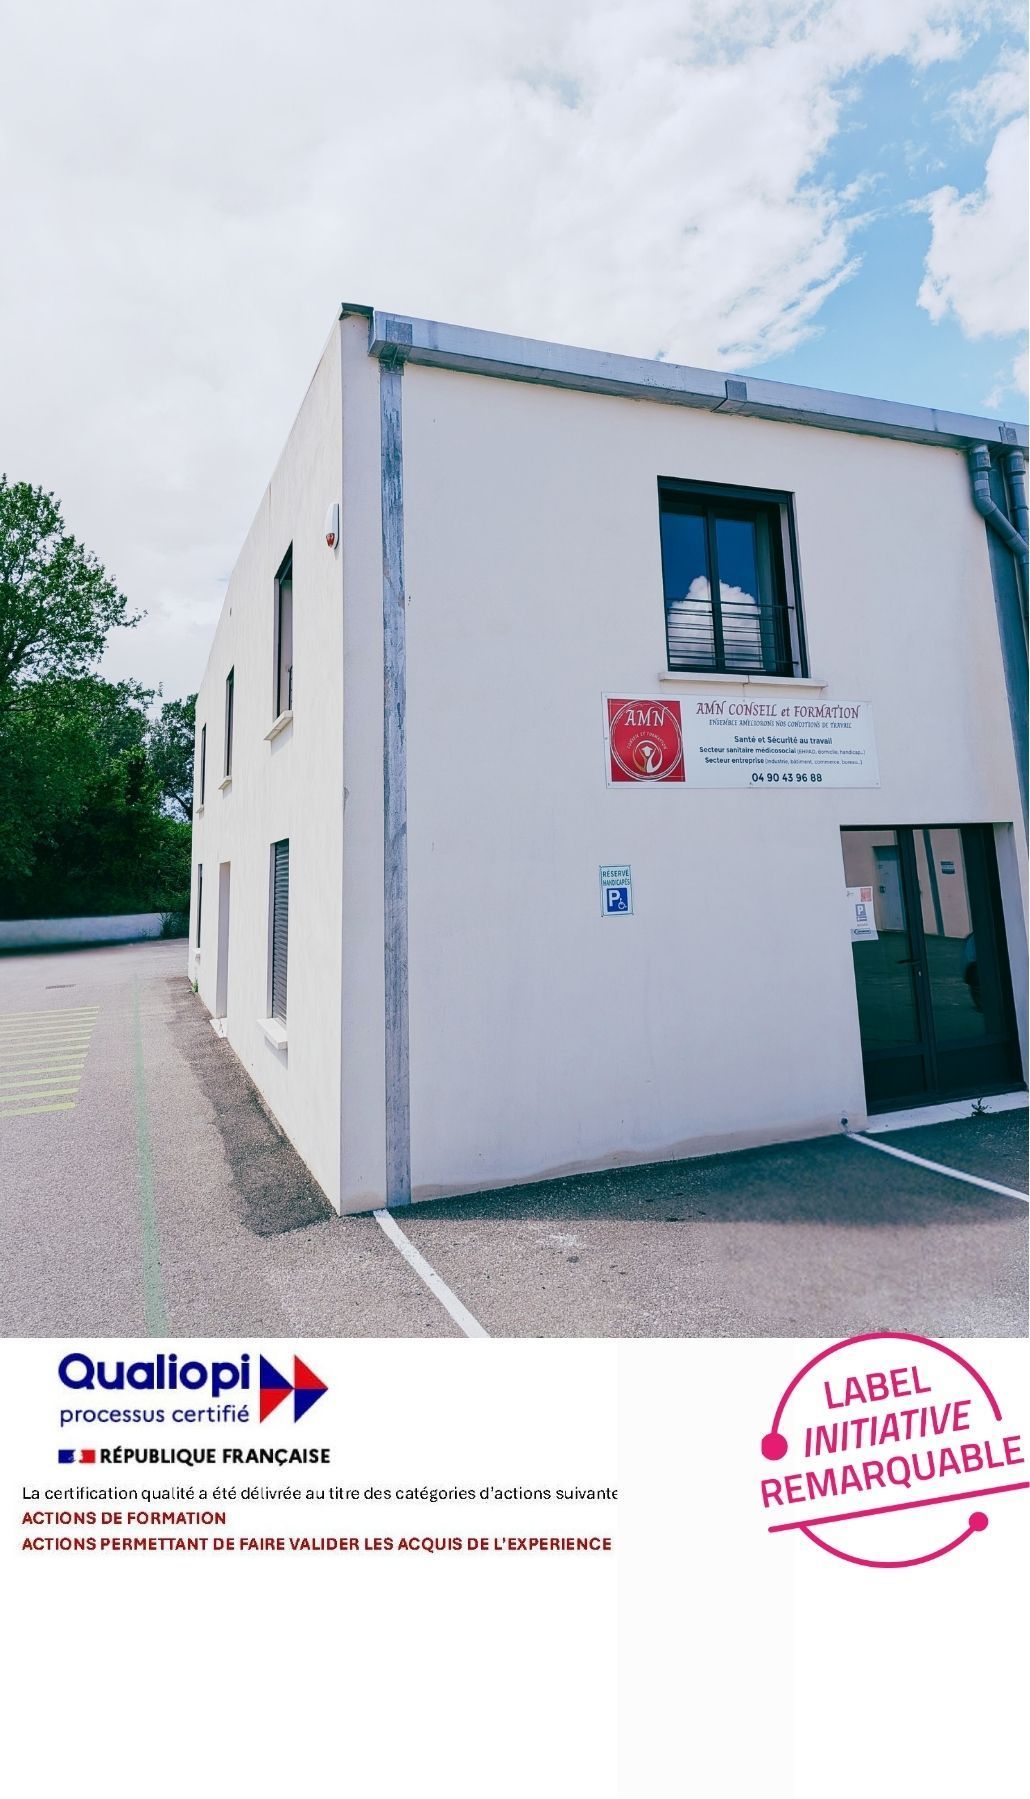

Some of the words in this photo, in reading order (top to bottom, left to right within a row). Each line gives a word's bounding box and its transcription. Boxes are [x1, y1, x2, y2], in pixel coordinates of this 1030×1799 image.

[624, 706, 668, 726] AMN
[696, 700, 727, 715] AMN
[728, 702, 778, 717] CONSEIL
[781, 707, 790, 717] et
[793, 704, 861, 719] FORMATION
[734, 735, 756, 743] Santé
[768, 736, 798, 744] Sécurité
[810, 737, 833, 745] travail
[731, 757, 765, 765] entreprise
[752, 773, 764, 782] 04
[767, 773, 780, 782] 90
[782, 773, 794, 782] 43
[796, 773, 808, 782] 96
[810, 773, 823, 783] 88
[609, 890, 620, 907] P
